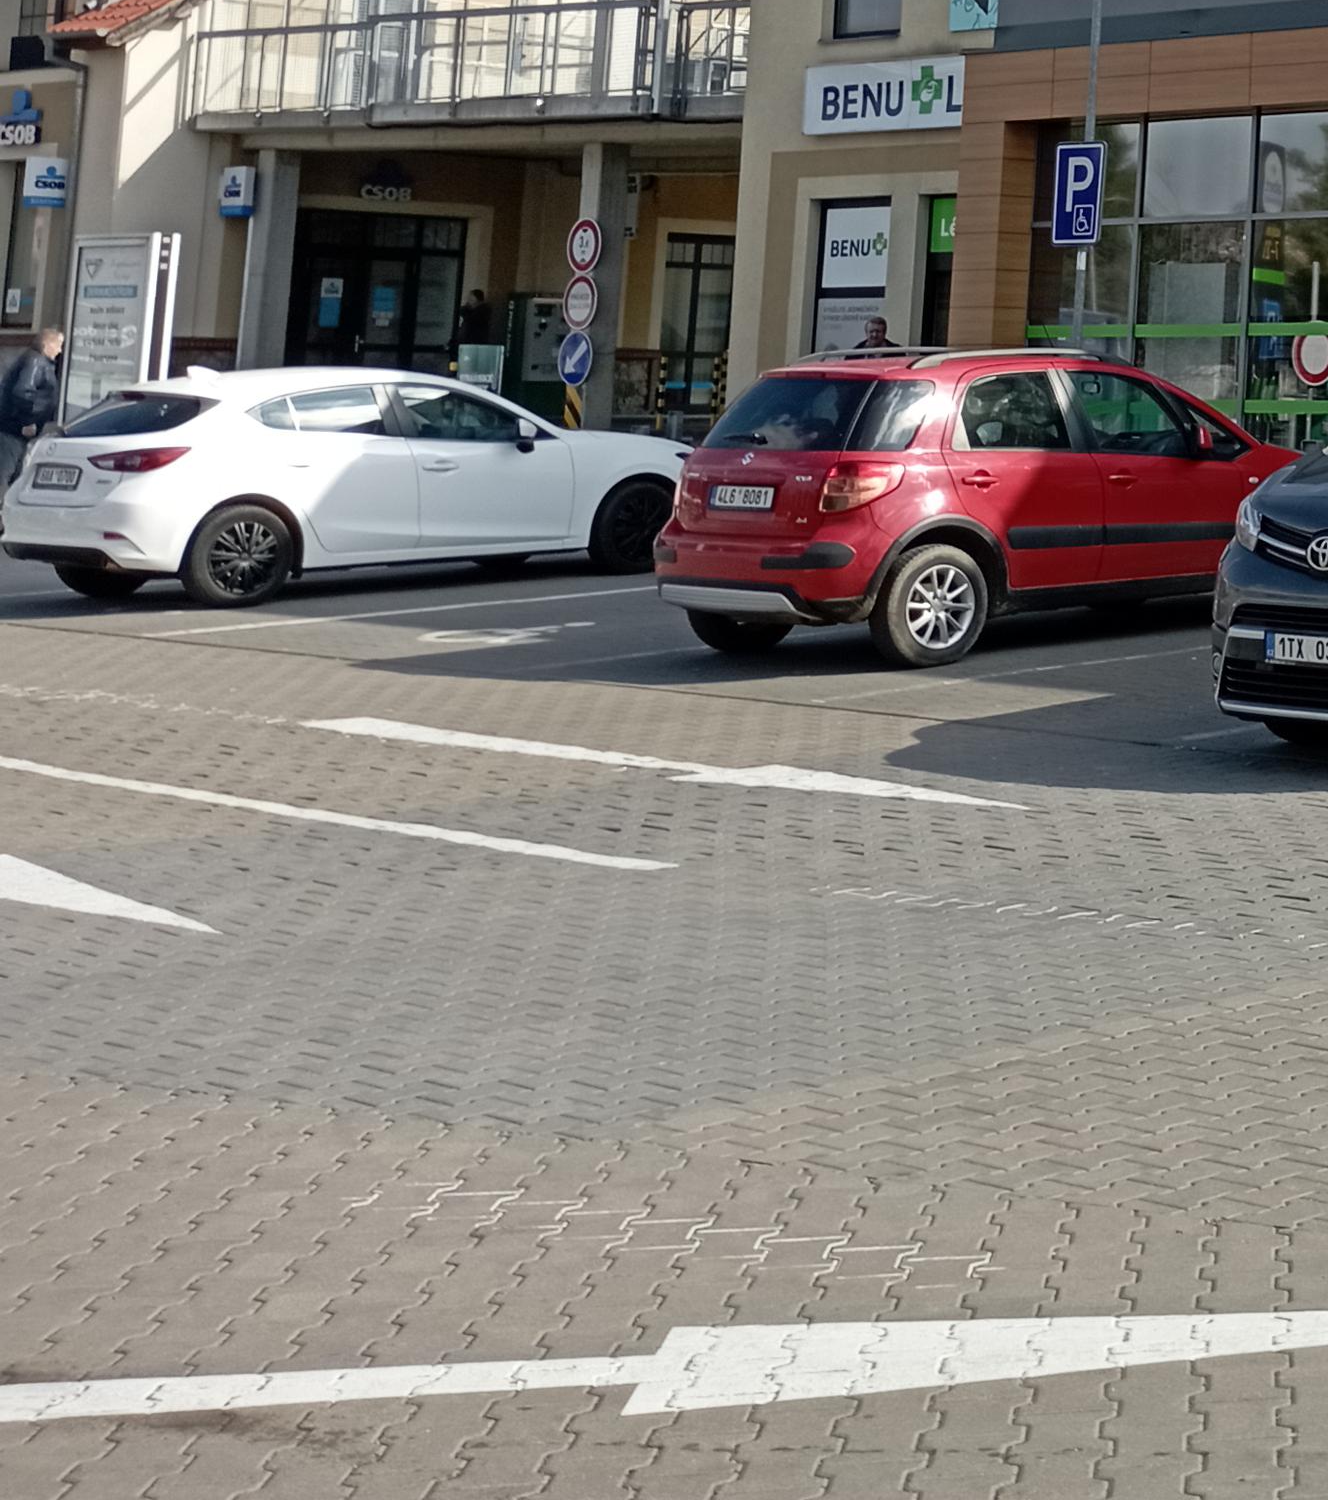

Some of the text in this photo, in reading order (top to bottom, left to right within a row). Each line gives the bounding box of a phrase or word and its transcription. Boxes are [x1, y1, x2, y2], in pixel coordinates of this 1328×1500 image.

[821, 80, 904, 121] BENU
[946, 75, 962, 113] L
[1065, 156, 1094, 213] P
[830, 239, 871, 257] BENU
[1279, 637, 1304, 659] 1TX
